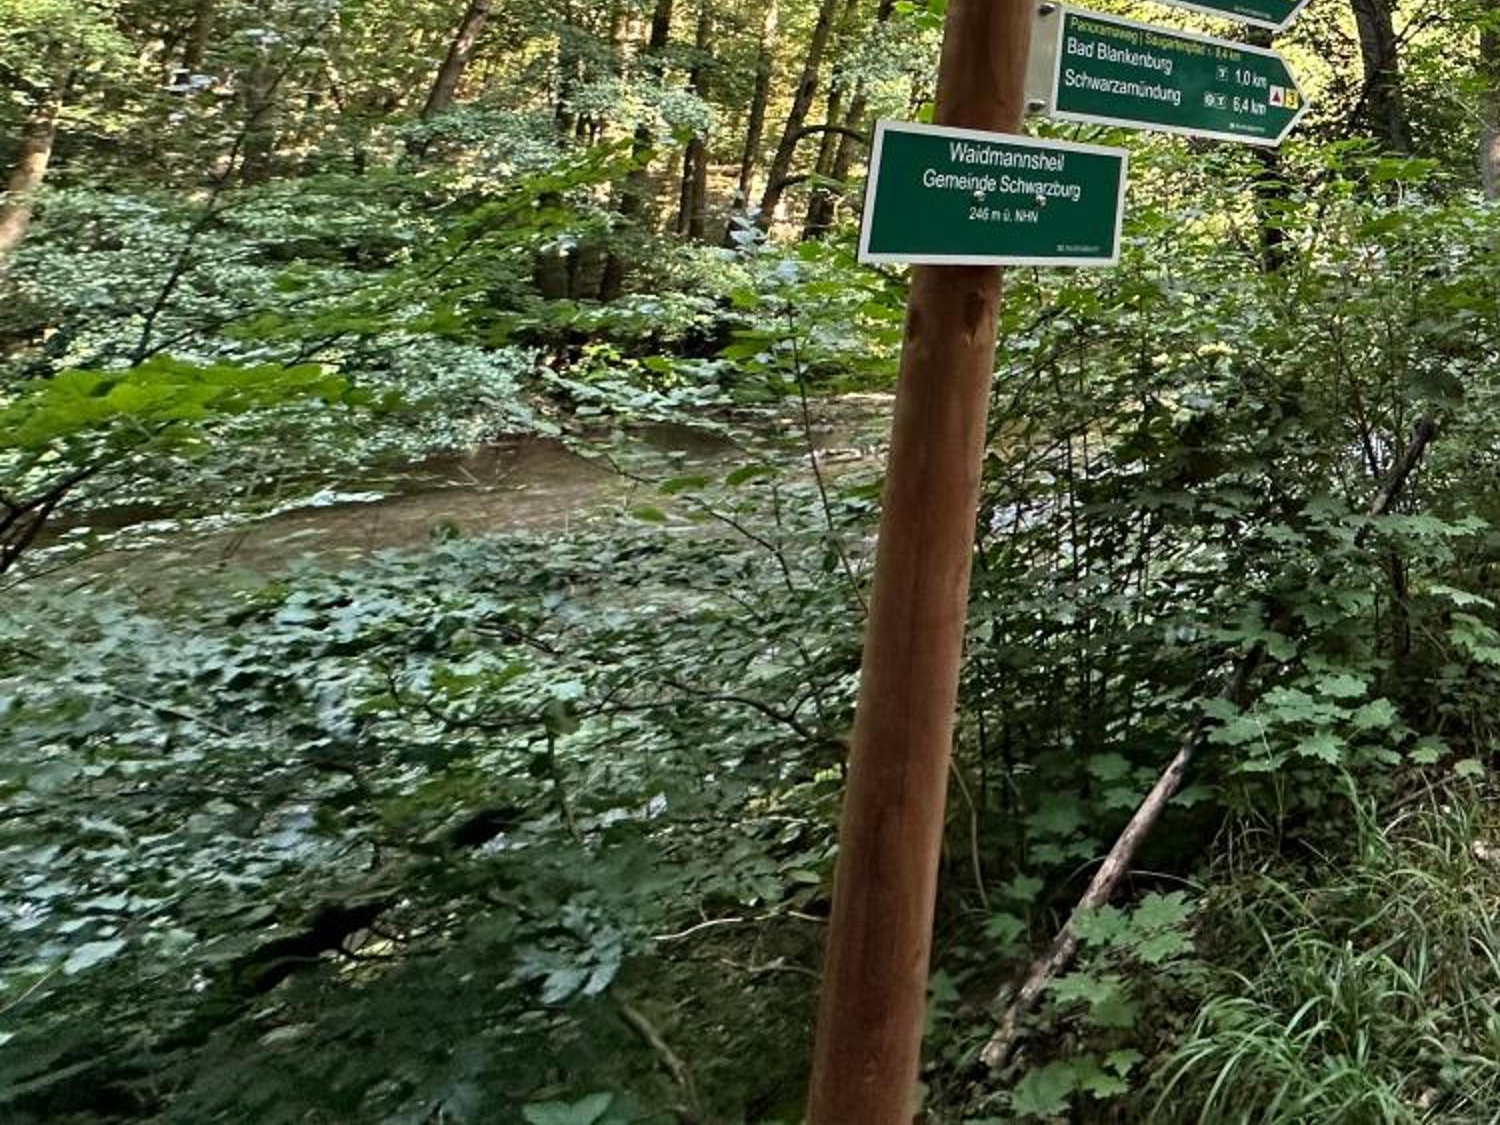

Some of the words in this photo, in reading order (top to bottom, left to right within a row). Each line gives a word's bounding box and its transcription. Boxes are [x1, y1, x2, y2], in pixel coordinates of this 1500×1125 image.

[1067, 36, 1094, 57] Bad
[1097, 43, 1173, 75] Blankenburg
[1252, 72, 1268, 89] km
[1064, 68, 1181, 106] Schwarzamündung
[1232, 95, 1249, 114] 6,4
[1251, 97, 1267, 116] km
[949, 141, 1065, 172] Waidmannsheil
[922, 168, 997, 193] Gemeinde
[999, 174, 1081, 202] Schwarzburg
[968, 206, 989, 221] 246
[991, 210, 1001, 221] m
[1015, 208, 1039, 223] NHN
